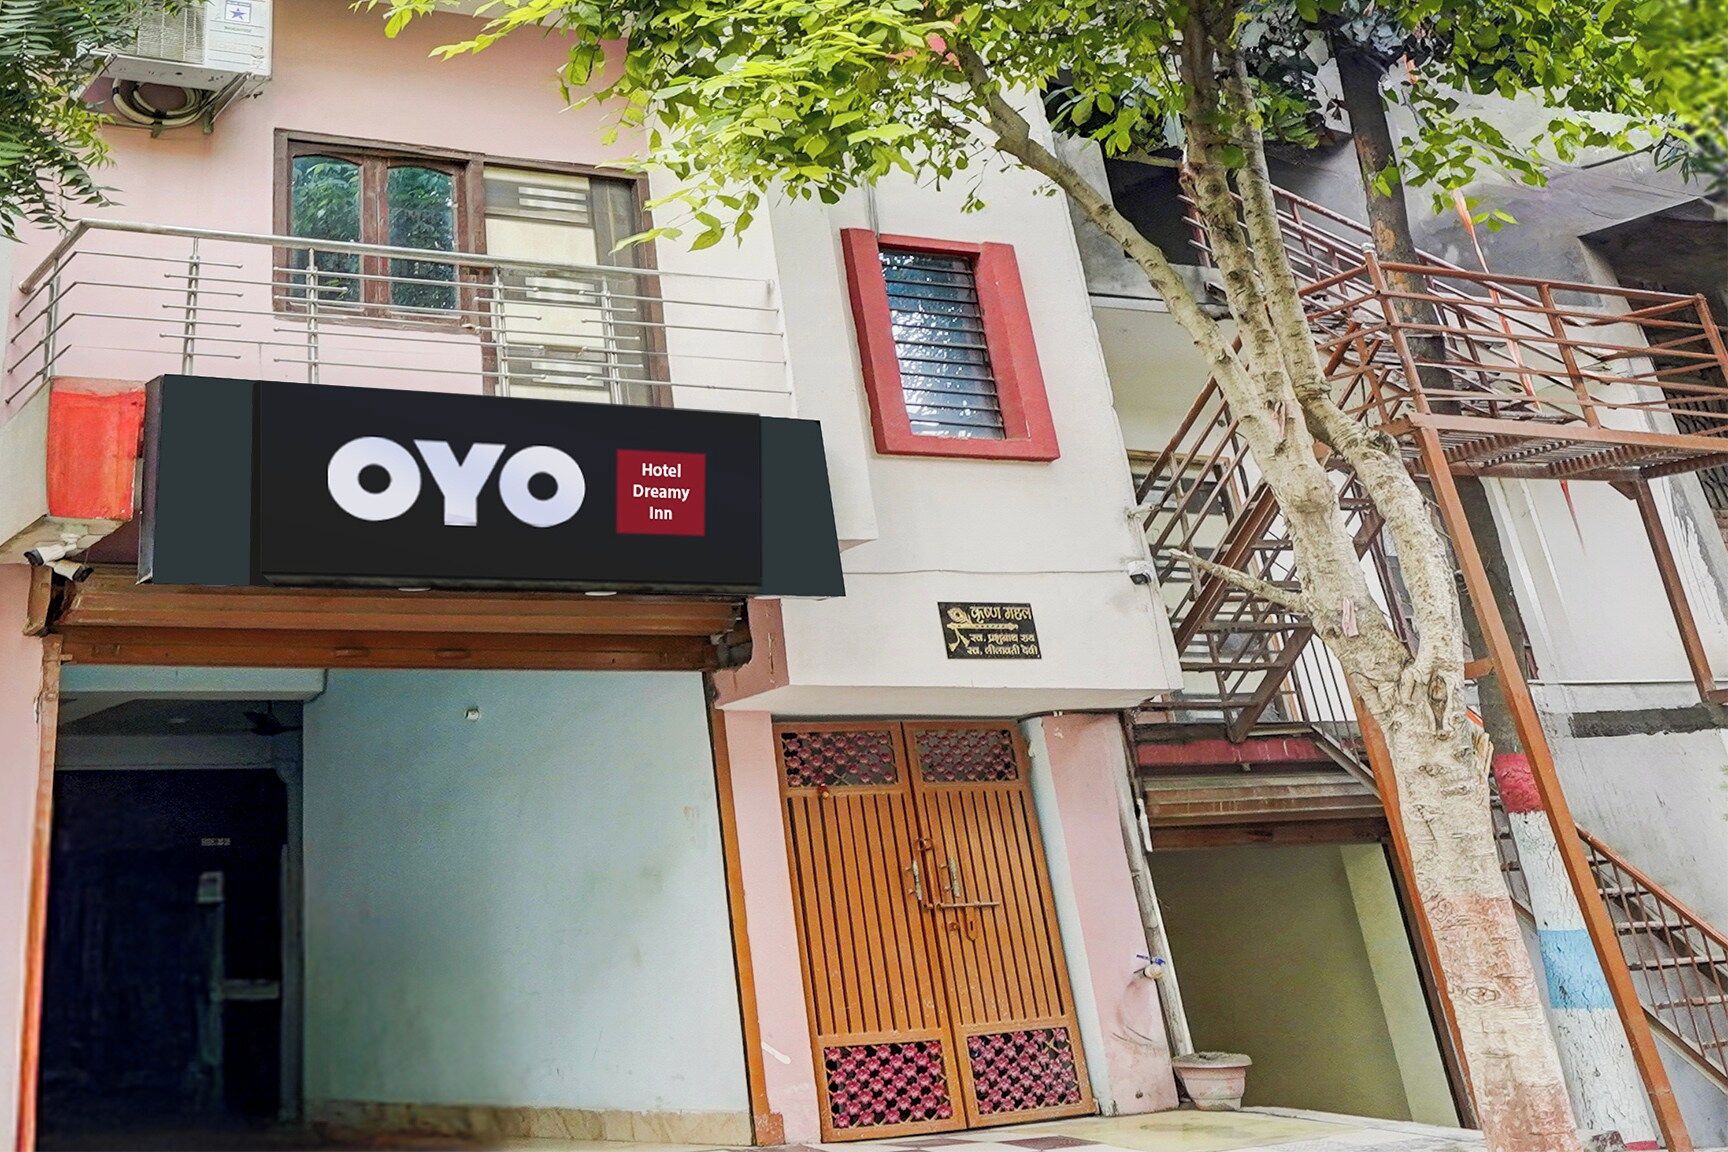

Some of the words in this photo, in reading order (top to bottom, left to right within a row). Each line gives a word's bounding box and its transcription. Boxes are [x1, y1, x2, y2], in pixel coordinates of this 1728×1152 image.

[641, 462, 682, 479] Hotel
[327, 435, 586, 528] OYO
[632, 483, 690, 503] Dreamy
[649, 506, 673, 521] Inn
[969, 606, 1002, 623] कृष्ण
[1002, 607, 1032, 620] महल
[1020, 644, 1038, 655] देवी
